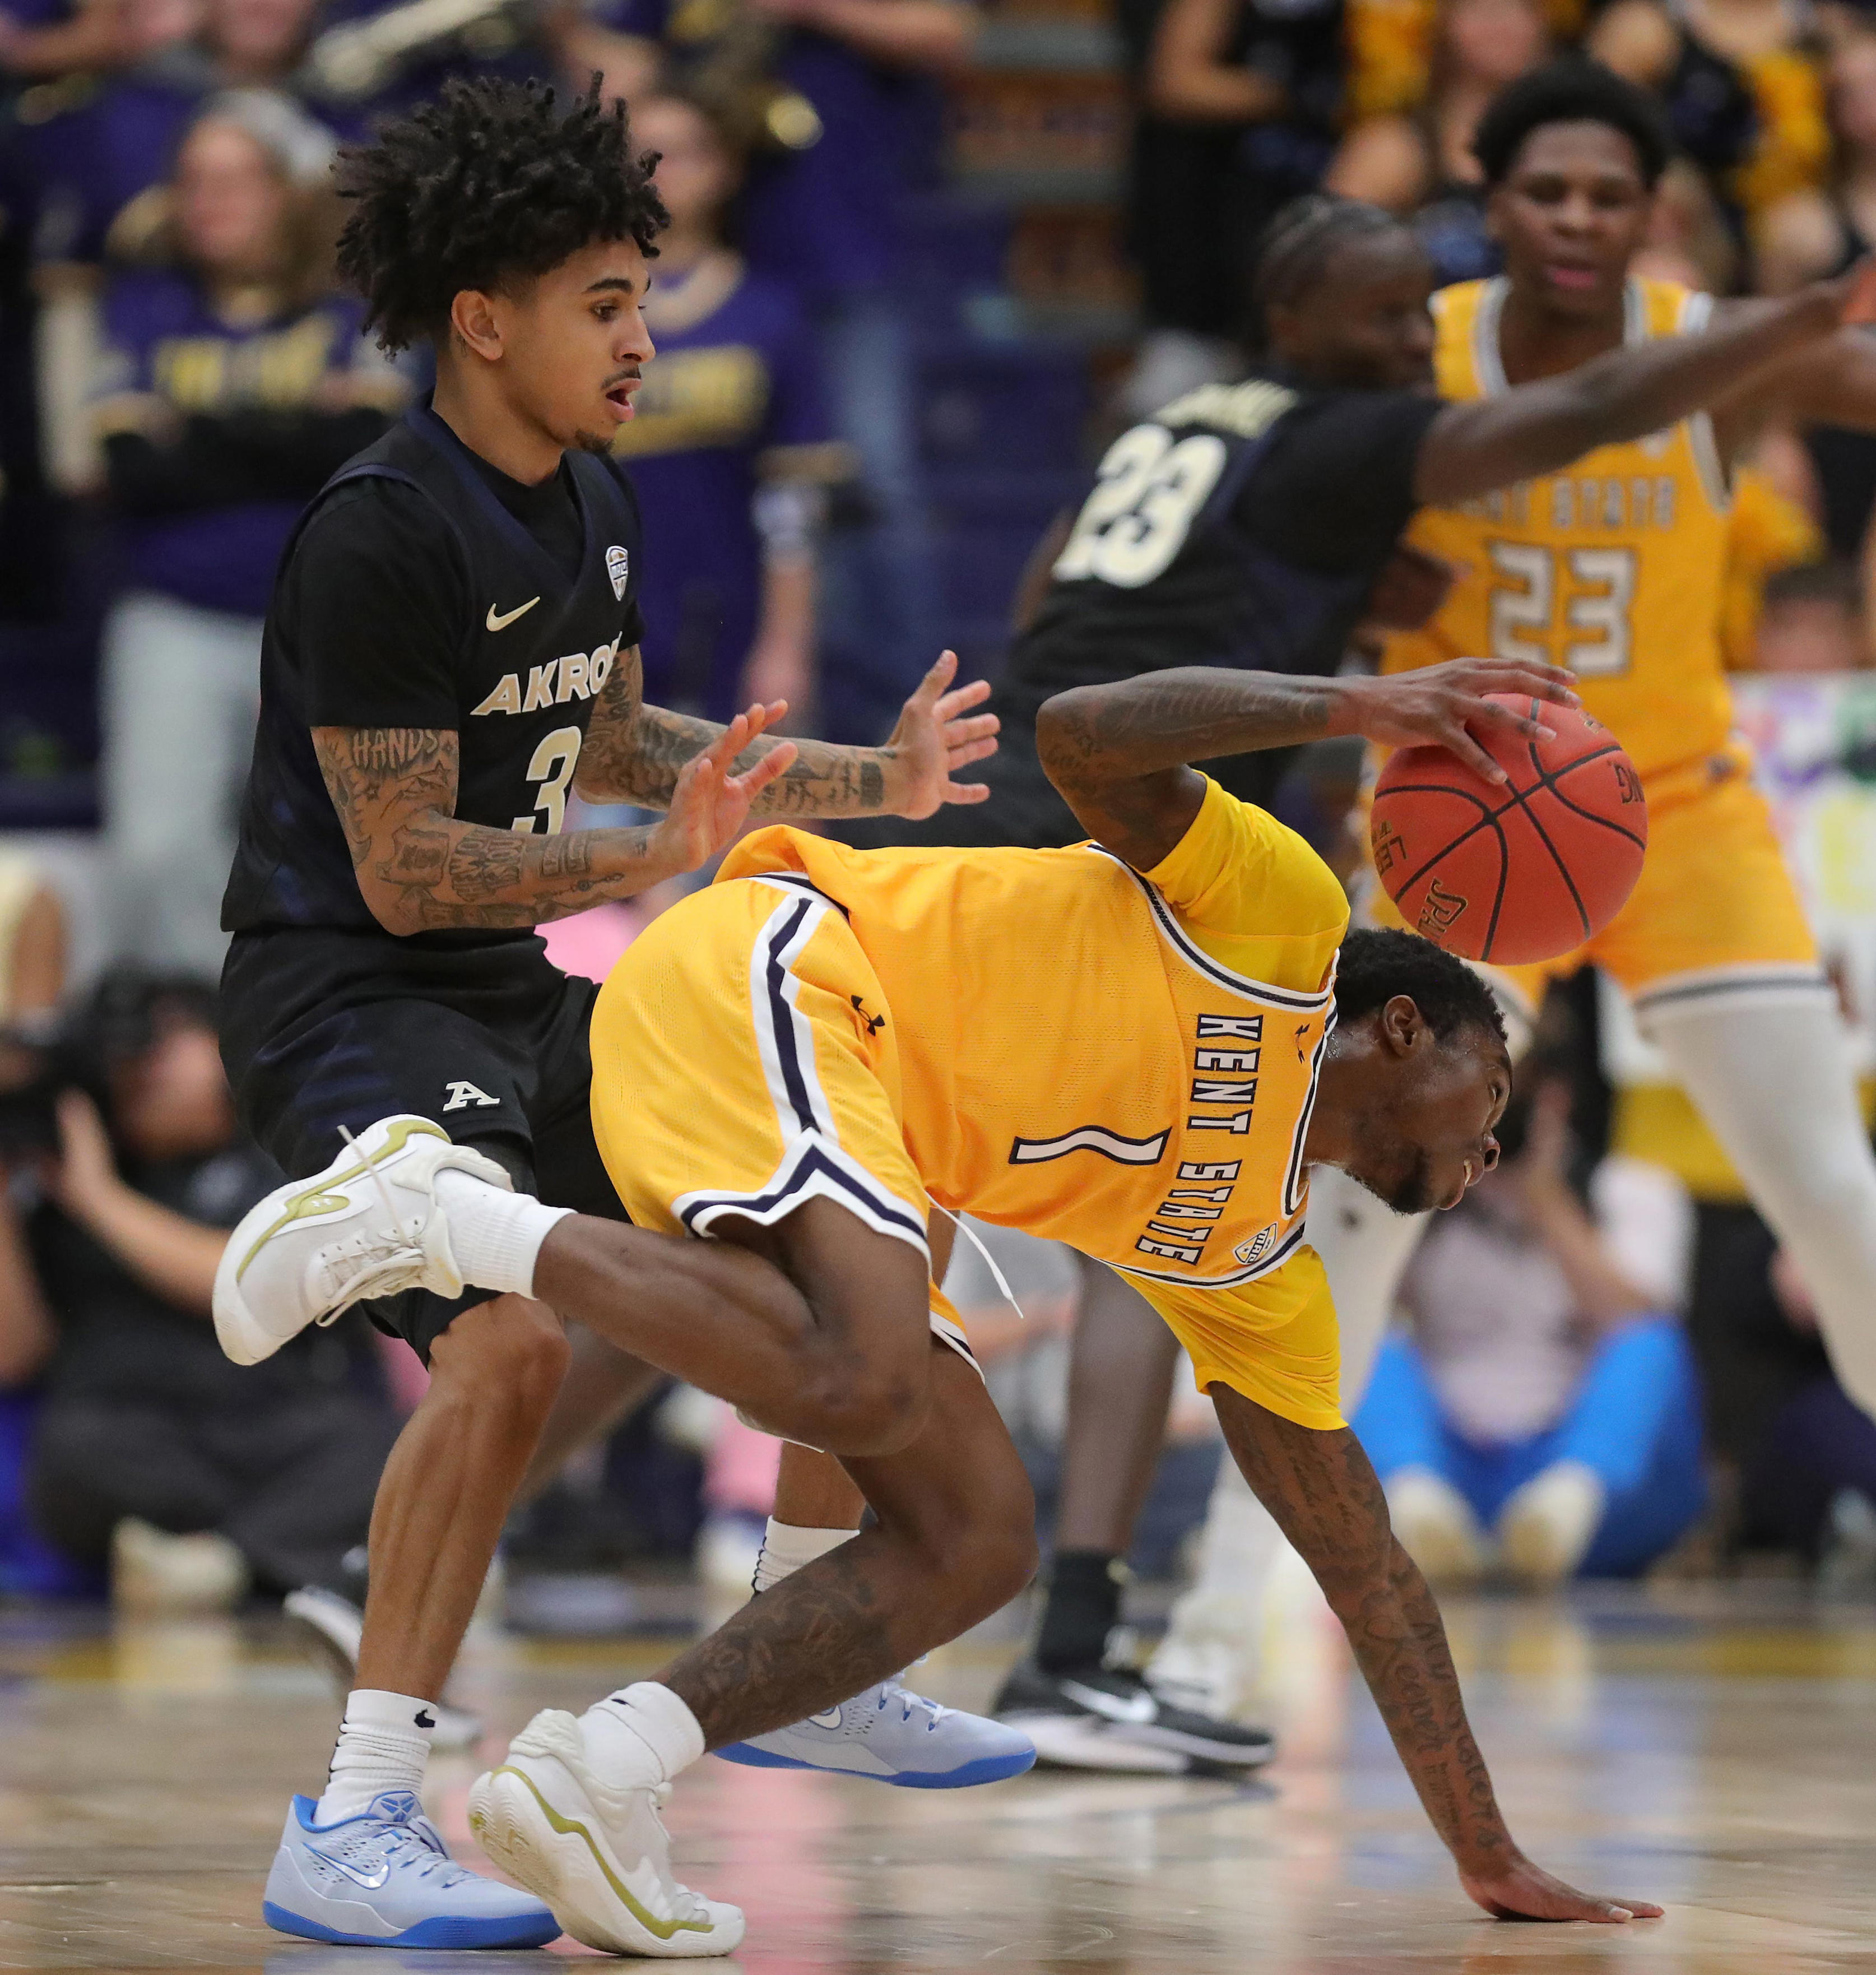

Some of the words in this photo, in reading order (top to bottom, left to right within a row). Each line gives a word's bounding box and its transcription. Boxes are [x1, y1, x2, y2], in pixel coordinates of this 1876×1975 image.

[1051, 423, 1227, 590] 23
[1485, 538, 1639, 680] 23
[510, 725, 582, 834] 3
[443, 1081, 500, 1112] A
[1186, 1013, 1264, 1134] KENT
[1009, 1125, 1173, 1165] 1
[1135, 1160, 1242, 1265] STATE
